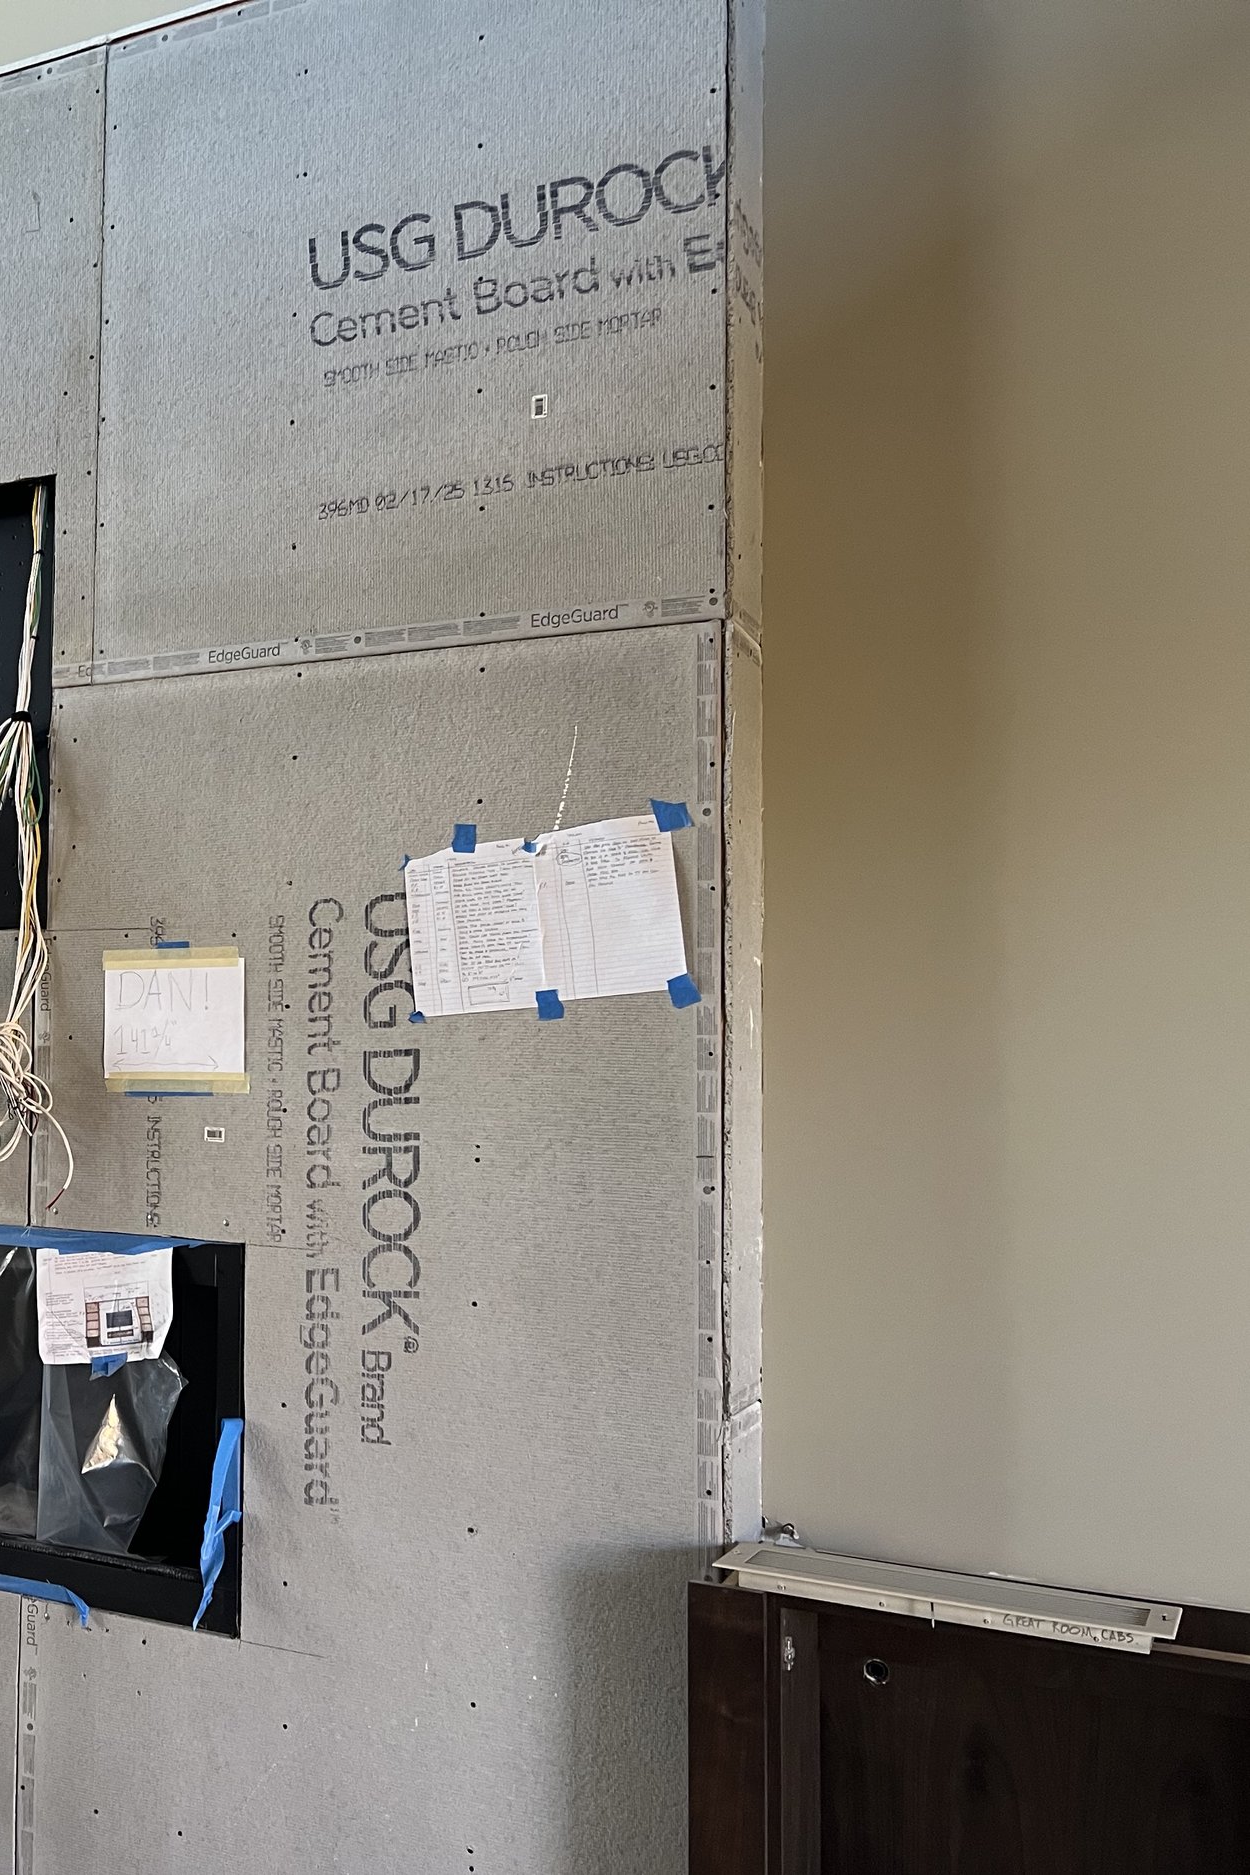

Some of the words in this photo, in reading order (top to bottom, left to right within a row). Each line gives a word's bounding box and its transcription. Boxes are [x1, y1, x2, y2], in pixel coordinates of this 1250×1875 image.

[308, 213, 436, 291] USG
[309, 286, 463, 348] Cement
[473, 256, 600, 316] Board
[609, 251, 677, 291] with
[385, 352, 418, 377] SIDE
[554, 320, 592, 346] SIDE
[374, 481, 466, 512] 02/17/25
[472, 474, 515, 498] 1315
[530, 605, 620, 630] EdgeGuard
[207, 642, 281, 667] EdgeGuard
[307, 897, 345, 1056] Cement
[363, 892, 416, 1029] USG
[114, 968, 209, 1012] DAN!
[267, 979, 285, 1013] SIDE
[306, 1067, 342, 1190] Board
[266, 1144, 283, 1178] SIDE
[305, 1199, 334, 1258] with
[300, 1267, 341, 1506] EdgeGuard
[361, 1350, 392, 1446] Brand
[1002, 1613, 1046, 1629] GREAT
[1052, 1620, 1094, 1638] ROOM
